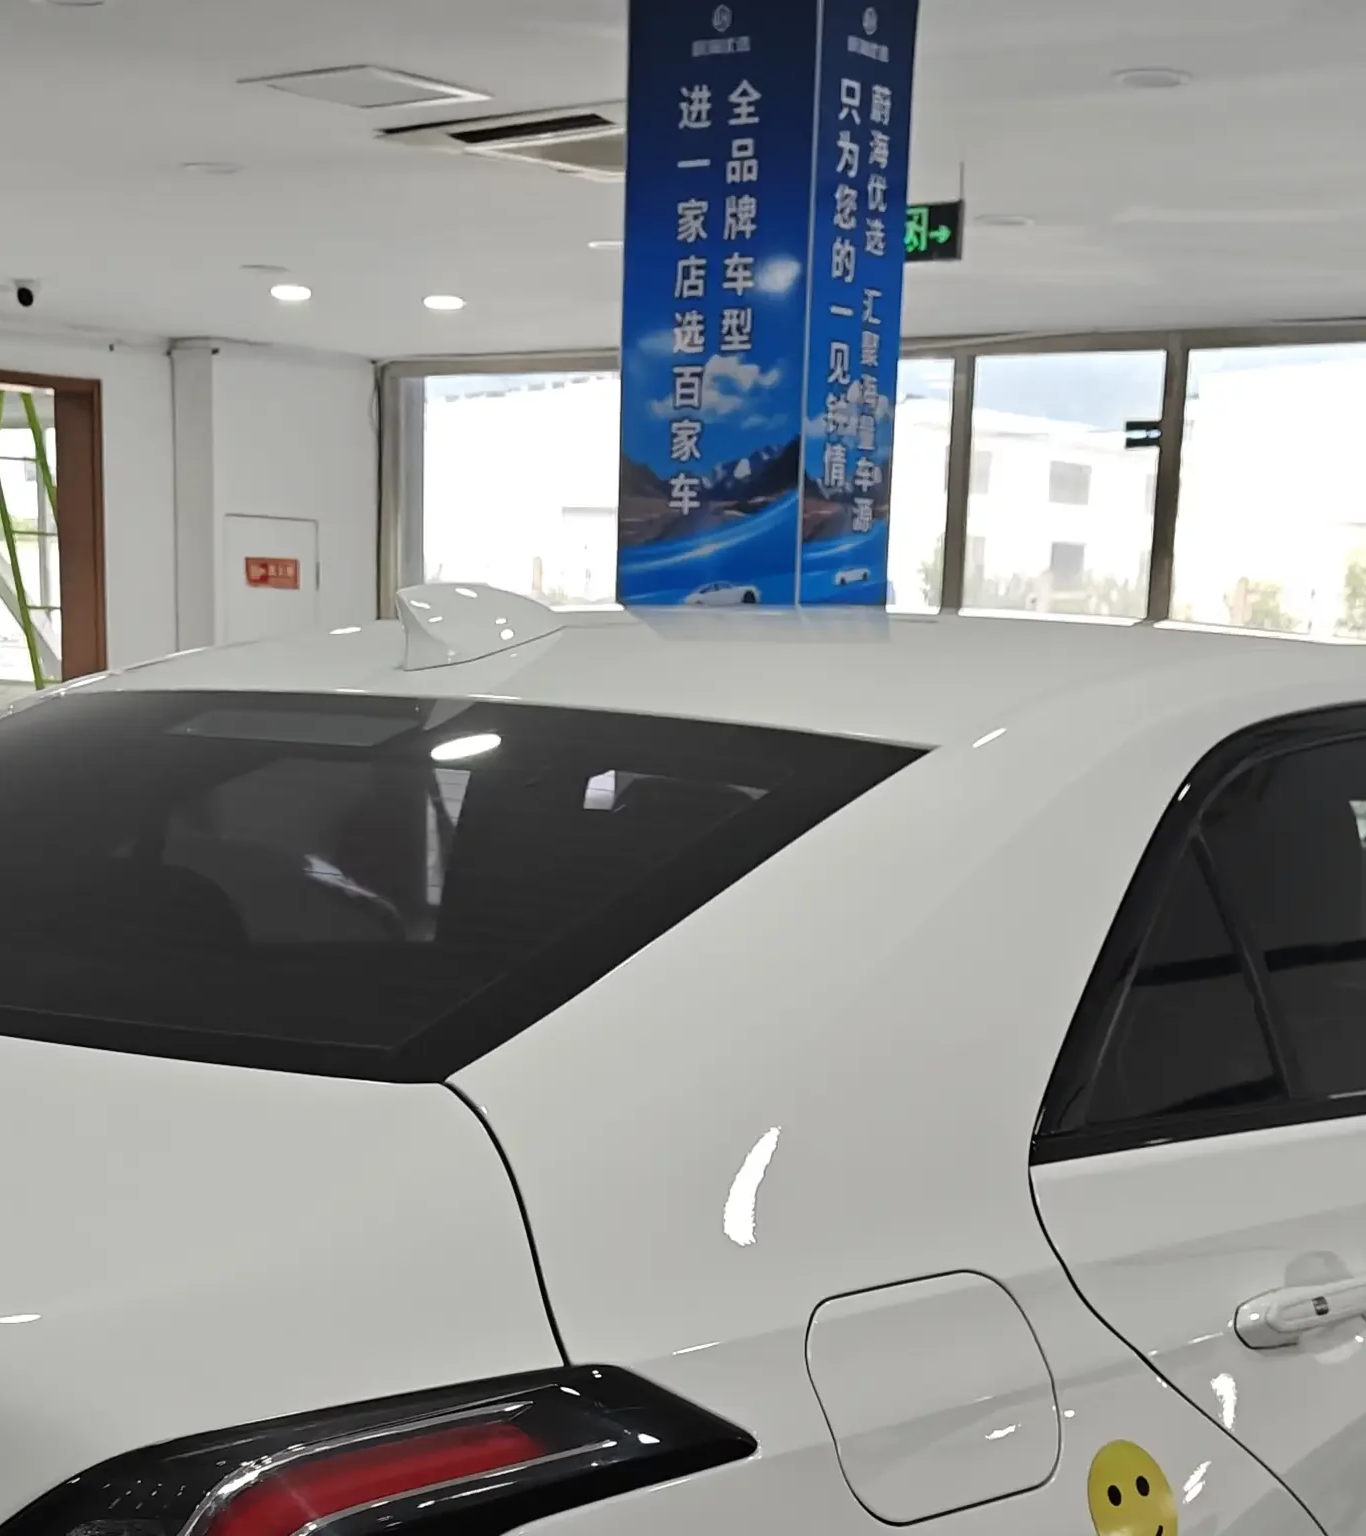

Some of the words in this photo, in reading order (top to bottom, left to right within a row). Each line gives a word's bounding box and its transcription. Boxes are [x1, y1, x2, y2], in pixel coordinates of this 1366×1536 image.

[668, 84, 712, 516] 进一家店选百家车
[720, 79, 762, 351] 全品牌车型
[824, 77, 861, 488] 只为您的一见钟情
